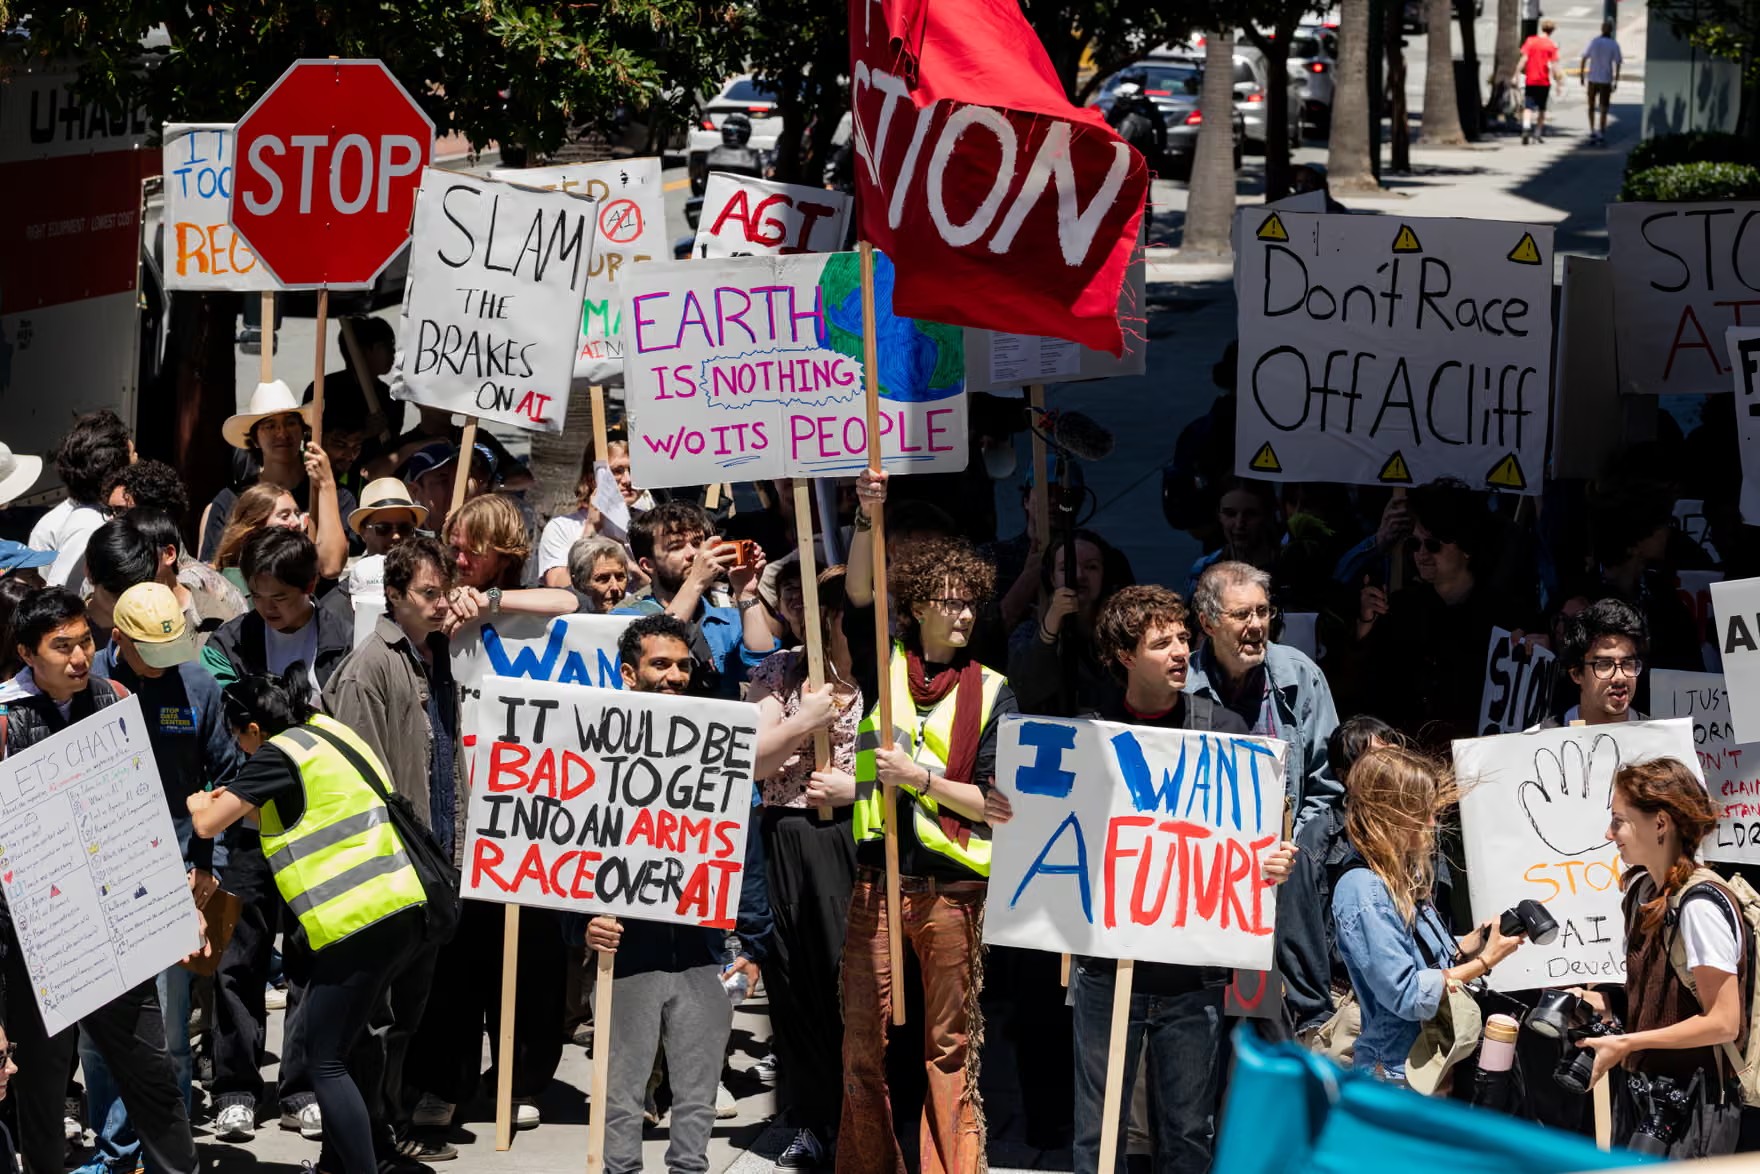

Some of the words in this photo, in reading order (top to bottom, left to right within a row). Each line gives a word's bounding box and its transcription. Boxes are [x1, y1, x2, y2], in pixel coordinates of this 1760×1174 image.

[242, 134, 421, 217] STOP
[438, 185, 584, 291] SLAM
[710, 189, 835, 254] AGI
[456, 288, 515, 319] THE
[633, 285, 828, 354] EARTH
[1264, 243, 1403, 328] Don't
[1416, 256, 1529, 337] Race
[415, 320, 538, 378] BRAKES
[651, 365, 697, 402] IS
[713, 358, 855, 399] NOTHING
[475, 381, 515, 411] ON
[514, 390, 552, 423] AI
[1252, 345, 1377, 434] Off
[1369, 357, 1422, 446] A
[1426, 361, 1537, 450] Cliff
[713, 421, 769, 456] ITS
[791, 409, 954, 460] PEOPLE
[65, 717, 128, 766] CHAT!
[497, 696, 559, 744] IT
[575, 704, 700, 759] WOULD
[700, 721, 757, 770] BE
[488, 741, 595, 801] BAD
[600, 755, 662, 809] TO
[667, 763, 748, 814] GET
[1015, 720, 1078, 799] I
[1109, 730, 1277, 833] WANT
[476, 795, 576, 847] INTO
[583, 805, 624, 849] AN
[626, 808, 741, 858] ARMS
[470, 838, 602, 900] RACE
[596, 853, 685, 906] OVER
[677, 861, 743, 930] AI
[1009, 811, 1094, 925] A
[1102, 815, 1277, 936] FUTURE
[1561, 915, 1611, 948] AI
